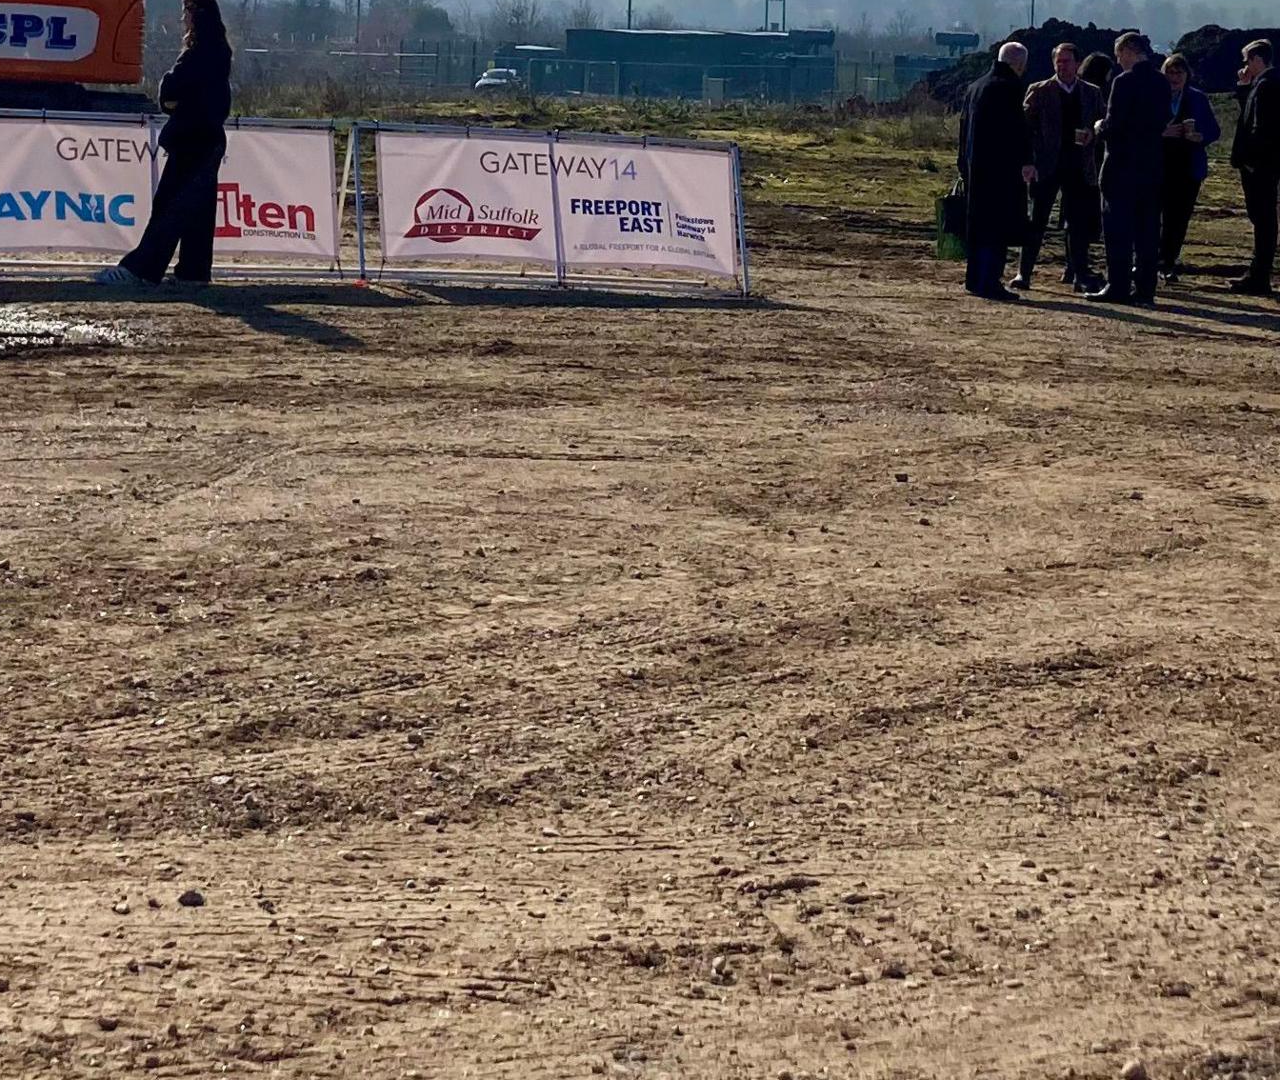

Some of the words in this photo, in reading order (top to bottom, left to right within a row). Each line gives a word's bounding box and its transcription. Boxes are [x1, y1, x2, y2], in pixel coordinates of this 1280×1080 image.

[426, 204, 462, 221] Mid
[478, 204, 539, 225] Suffolk
[570, 198, 662, 217] FREEPORT
[420, 225, 529, 238] DISTRICT
[620, 217, 664, 234] EAST
[243, 229, 301, 240] CONSTRUCTION
